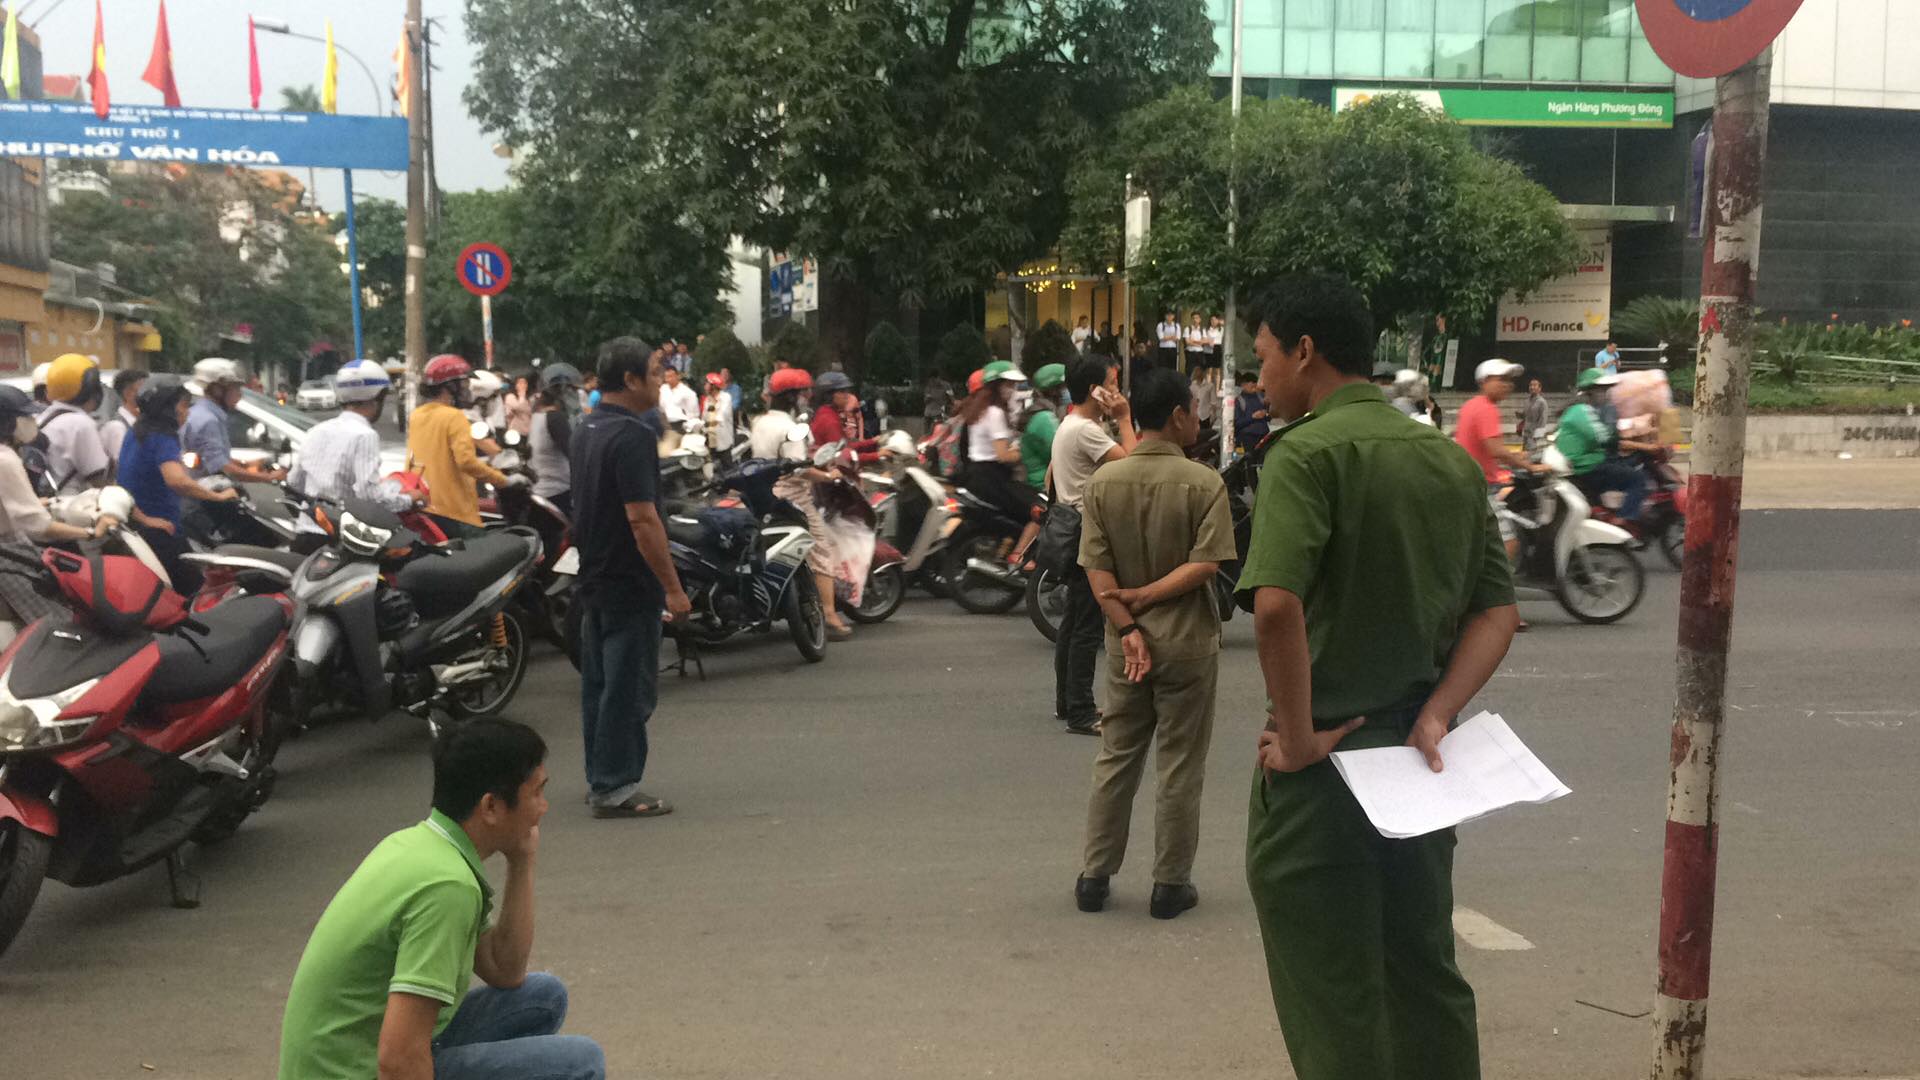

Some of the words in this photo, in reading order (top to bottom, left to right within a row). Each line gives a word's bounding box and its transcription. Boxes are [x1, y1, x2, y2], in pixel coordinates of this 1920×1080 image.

[1575, 103, 1600, 115] Hàng
[84, 126, 124, 138] KHU
[206, 144, 280, 164] HÓA
[1502, 316, 1530, 332] HD
[1532, 320, 1584, 332] Finance
